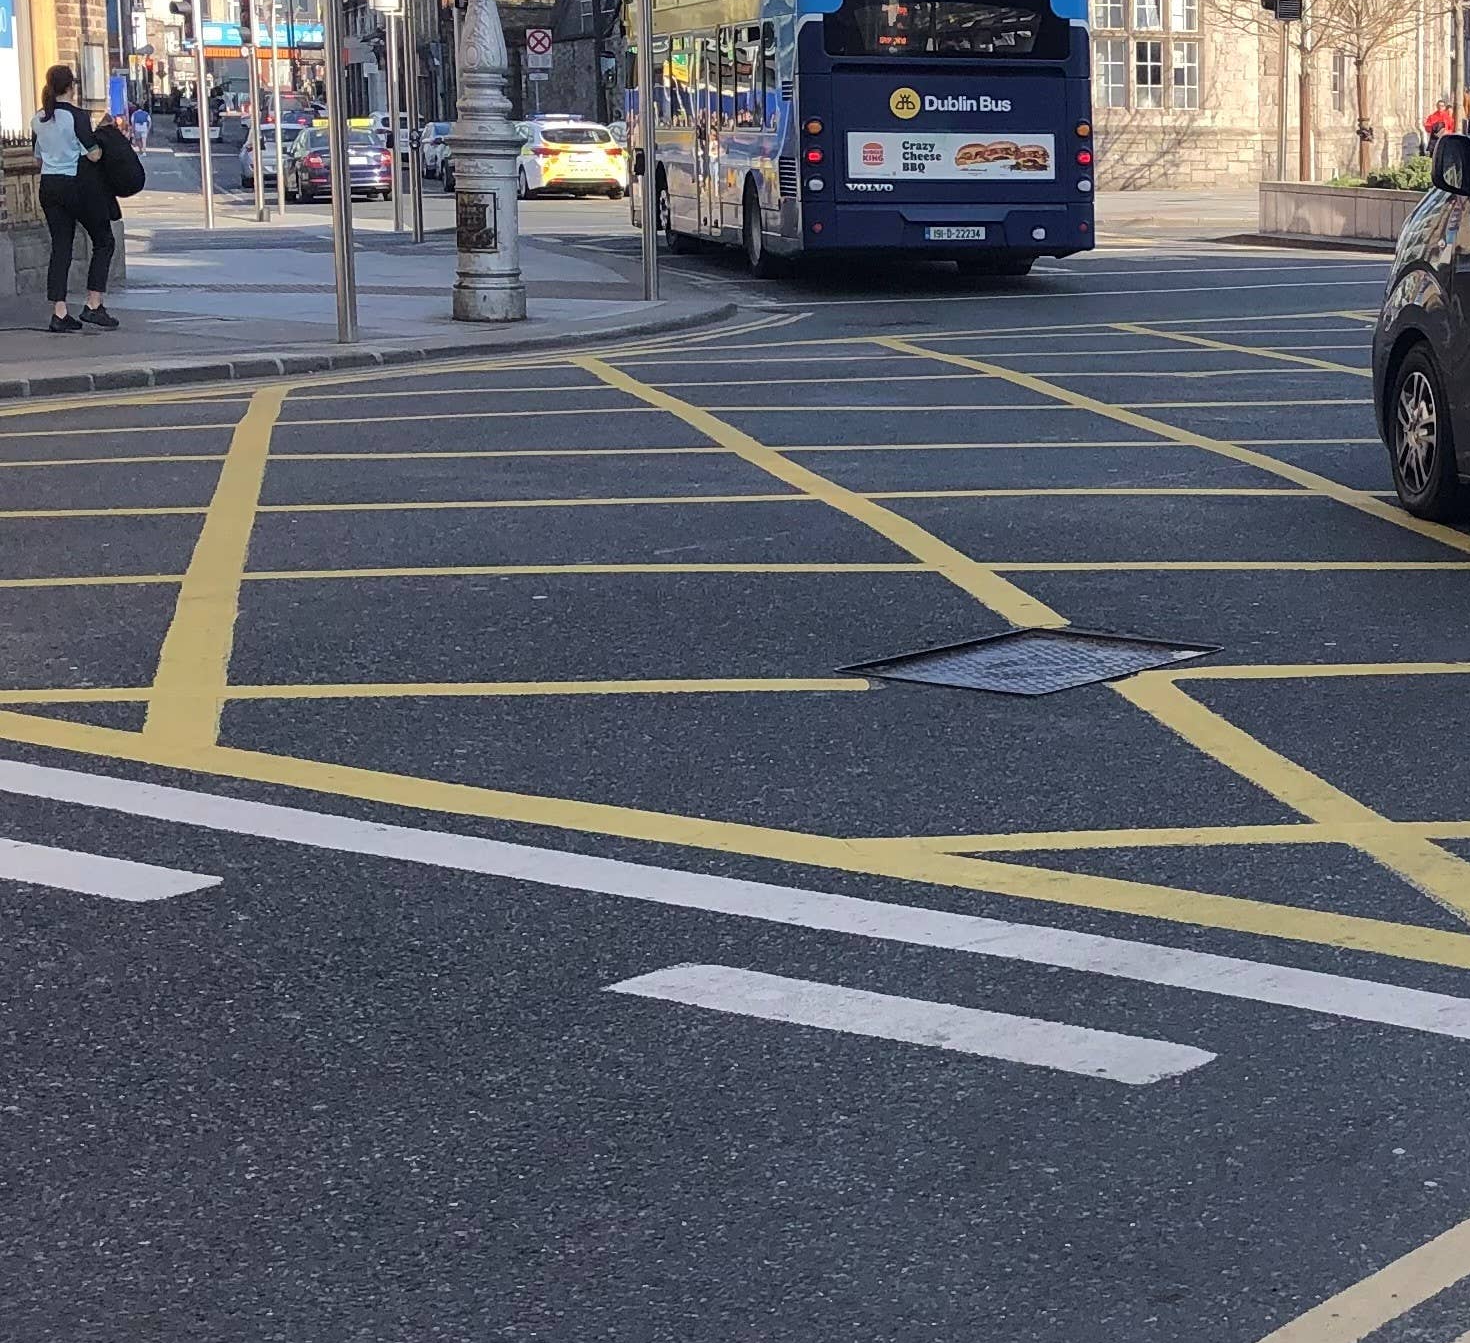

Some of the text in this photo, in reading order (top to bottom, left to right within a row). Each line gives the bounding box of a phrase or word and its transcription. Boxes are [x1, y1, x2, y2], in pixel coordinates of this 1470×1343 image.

[924, 96, 1011, 112] Dublin Bus
[902, 141, 936, 152] Crazy
[902, 152, 942, 161] Cheese
[902, 162, 926, 174] BBQ
[845, 183, 894, 192] VOLVO
[933, 228, 981, 239] 191-D-22234
